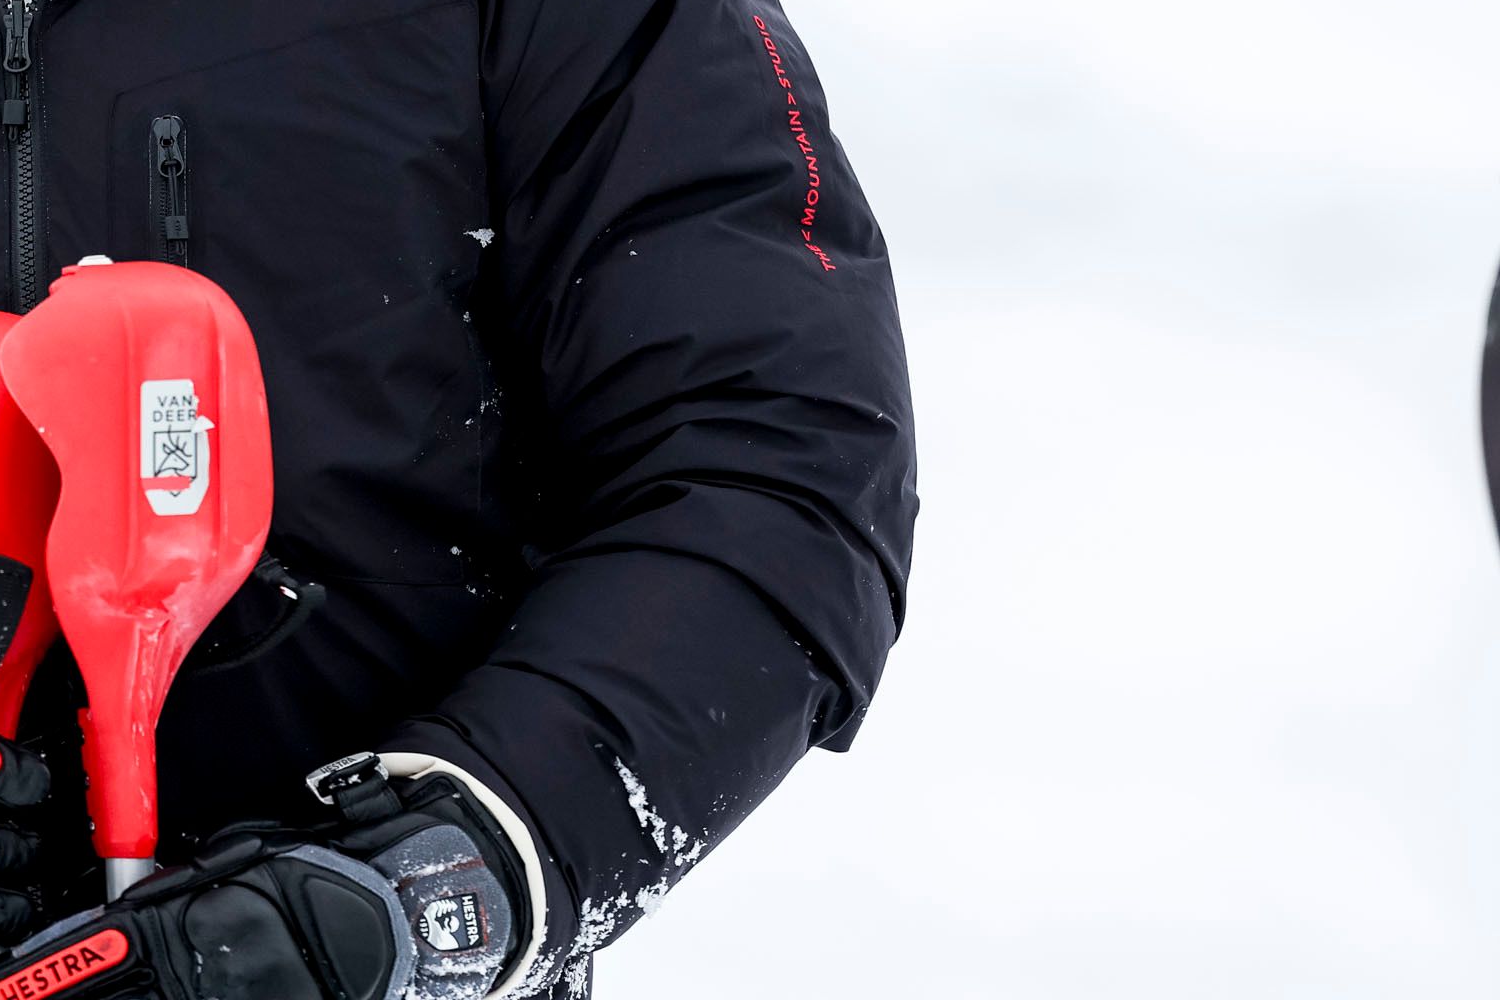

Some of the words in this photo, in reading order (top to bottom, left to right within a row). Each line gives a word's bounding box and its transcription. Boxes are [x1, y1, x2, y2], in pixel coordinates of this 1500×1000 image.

[753, 15, 791, 89] STUDIO
[788, 110, 820, 226] MOUNTAIN
[804, 243, 837, 272] THE
[152, 409, 198, 423] DEER
[157, 395, 194, 407] VAN
[461, 895, 480, 946] HESTRA
[0, 946, 106, 1000] HESTRA
